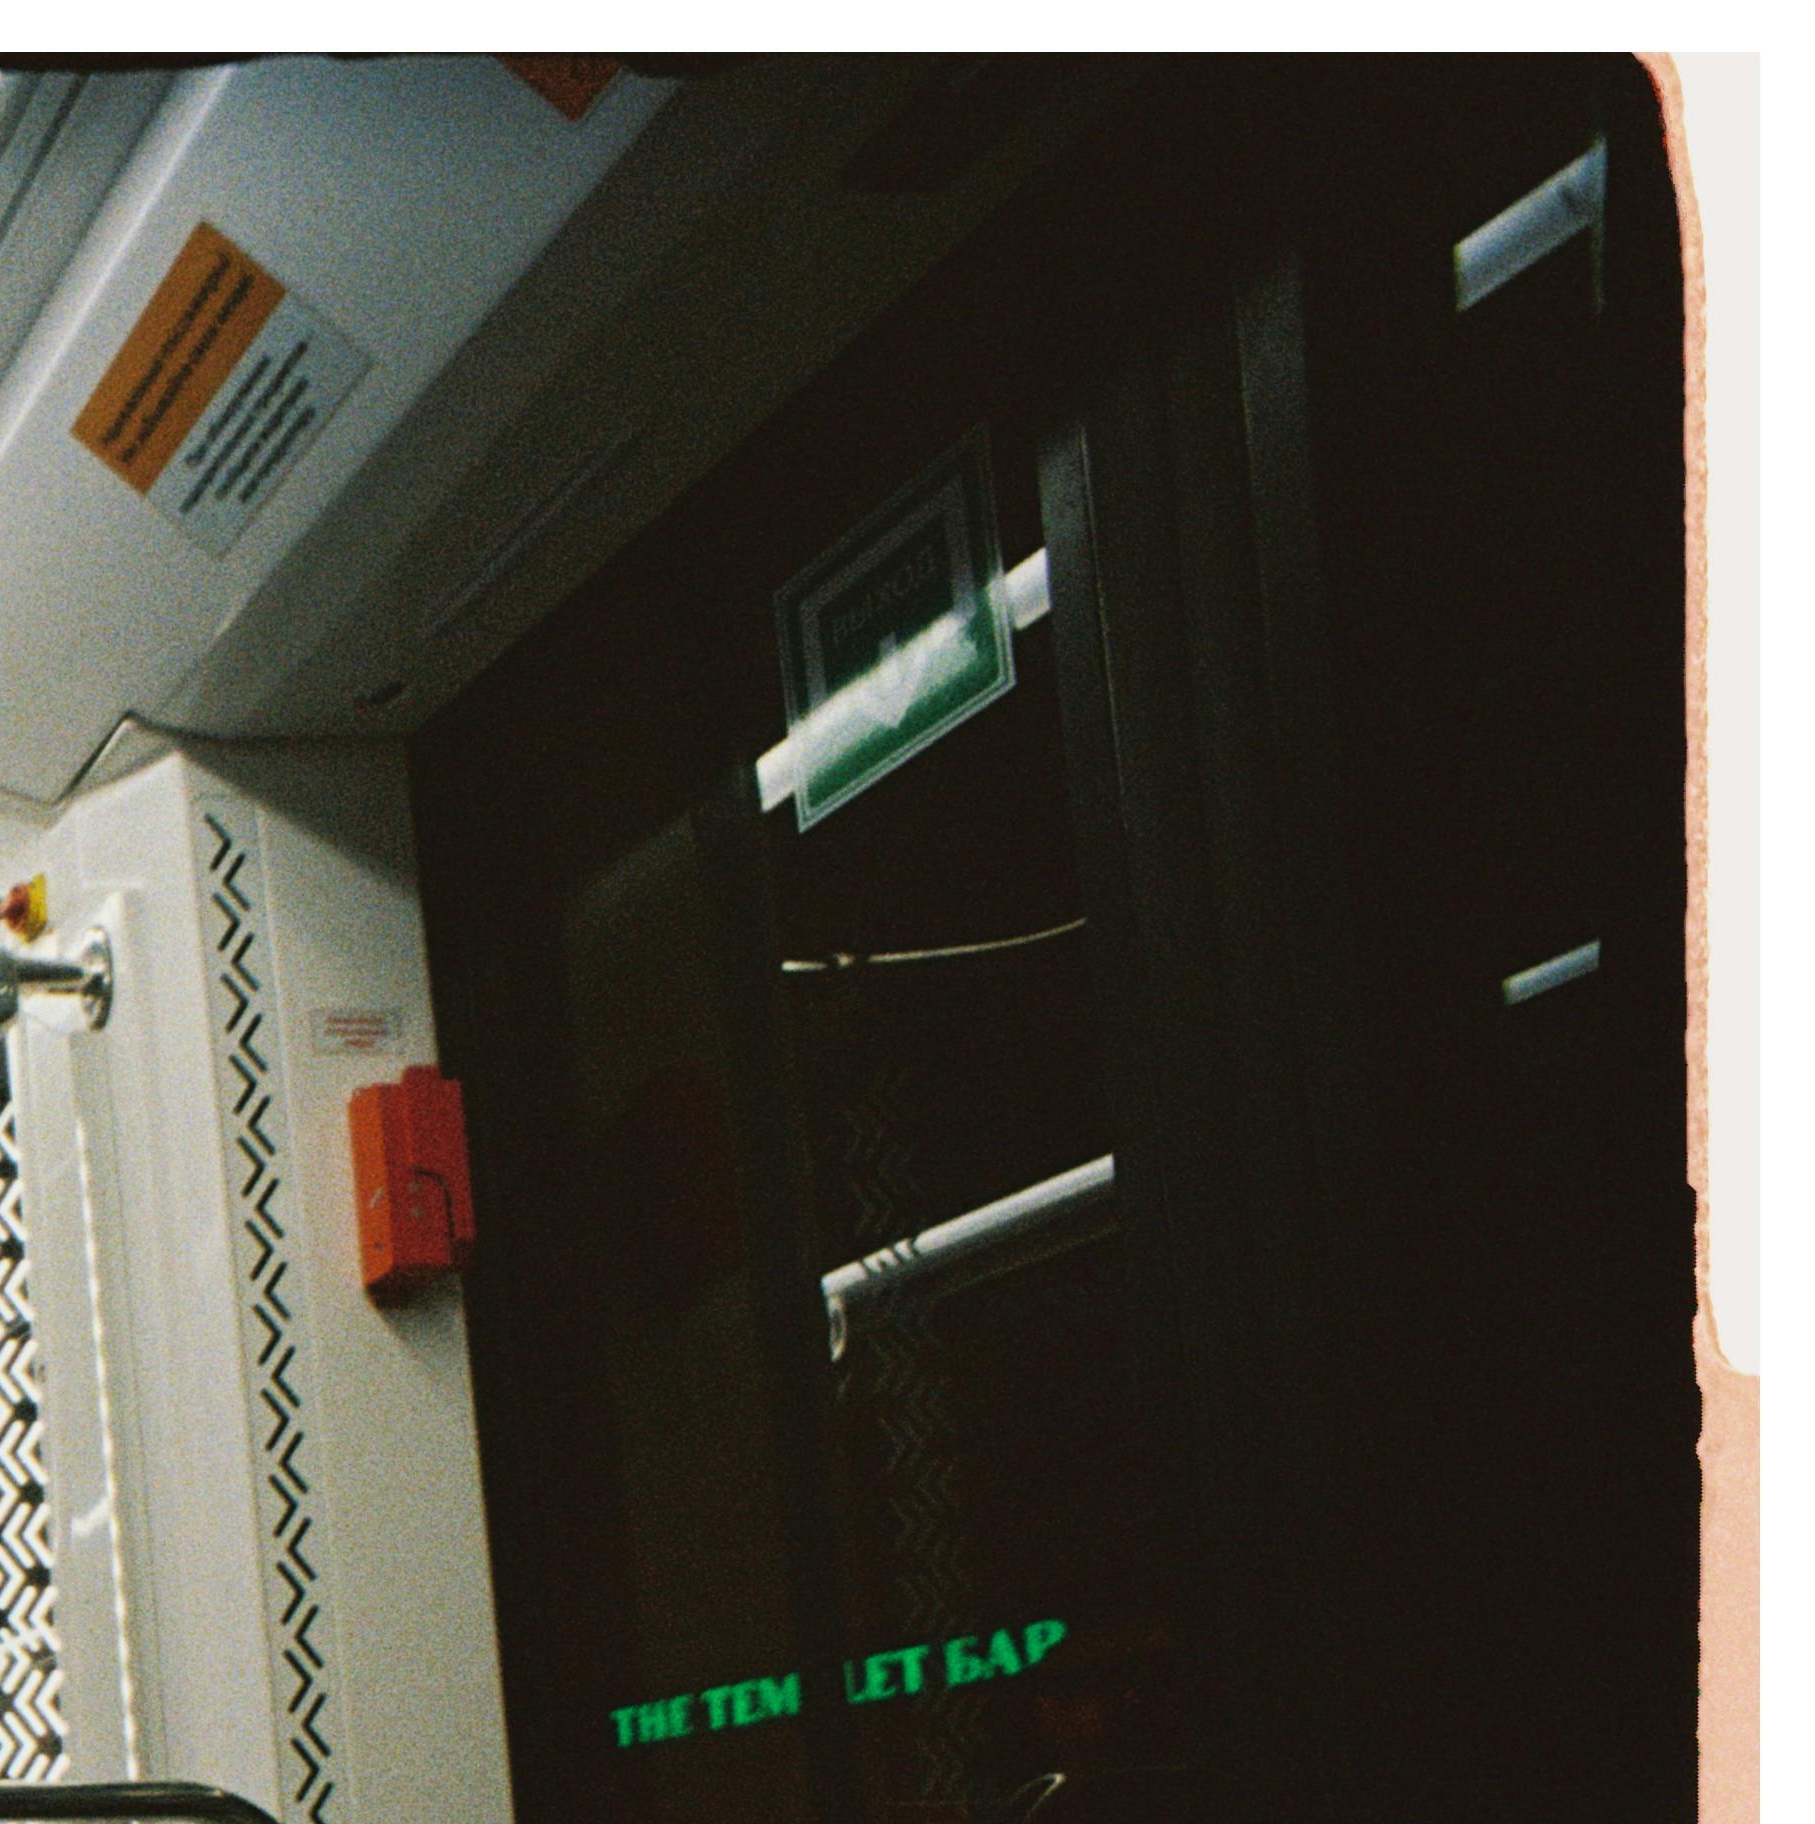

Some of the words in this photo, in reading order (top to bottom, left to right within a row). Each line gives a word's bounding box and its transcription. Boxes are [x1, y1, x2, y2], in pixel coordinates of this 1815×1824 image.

[610, 1693, 692, 1748] THE
[700, 1643, 930, 1731] TEMLET
[943, 1618, 1068, 1687] БАР
